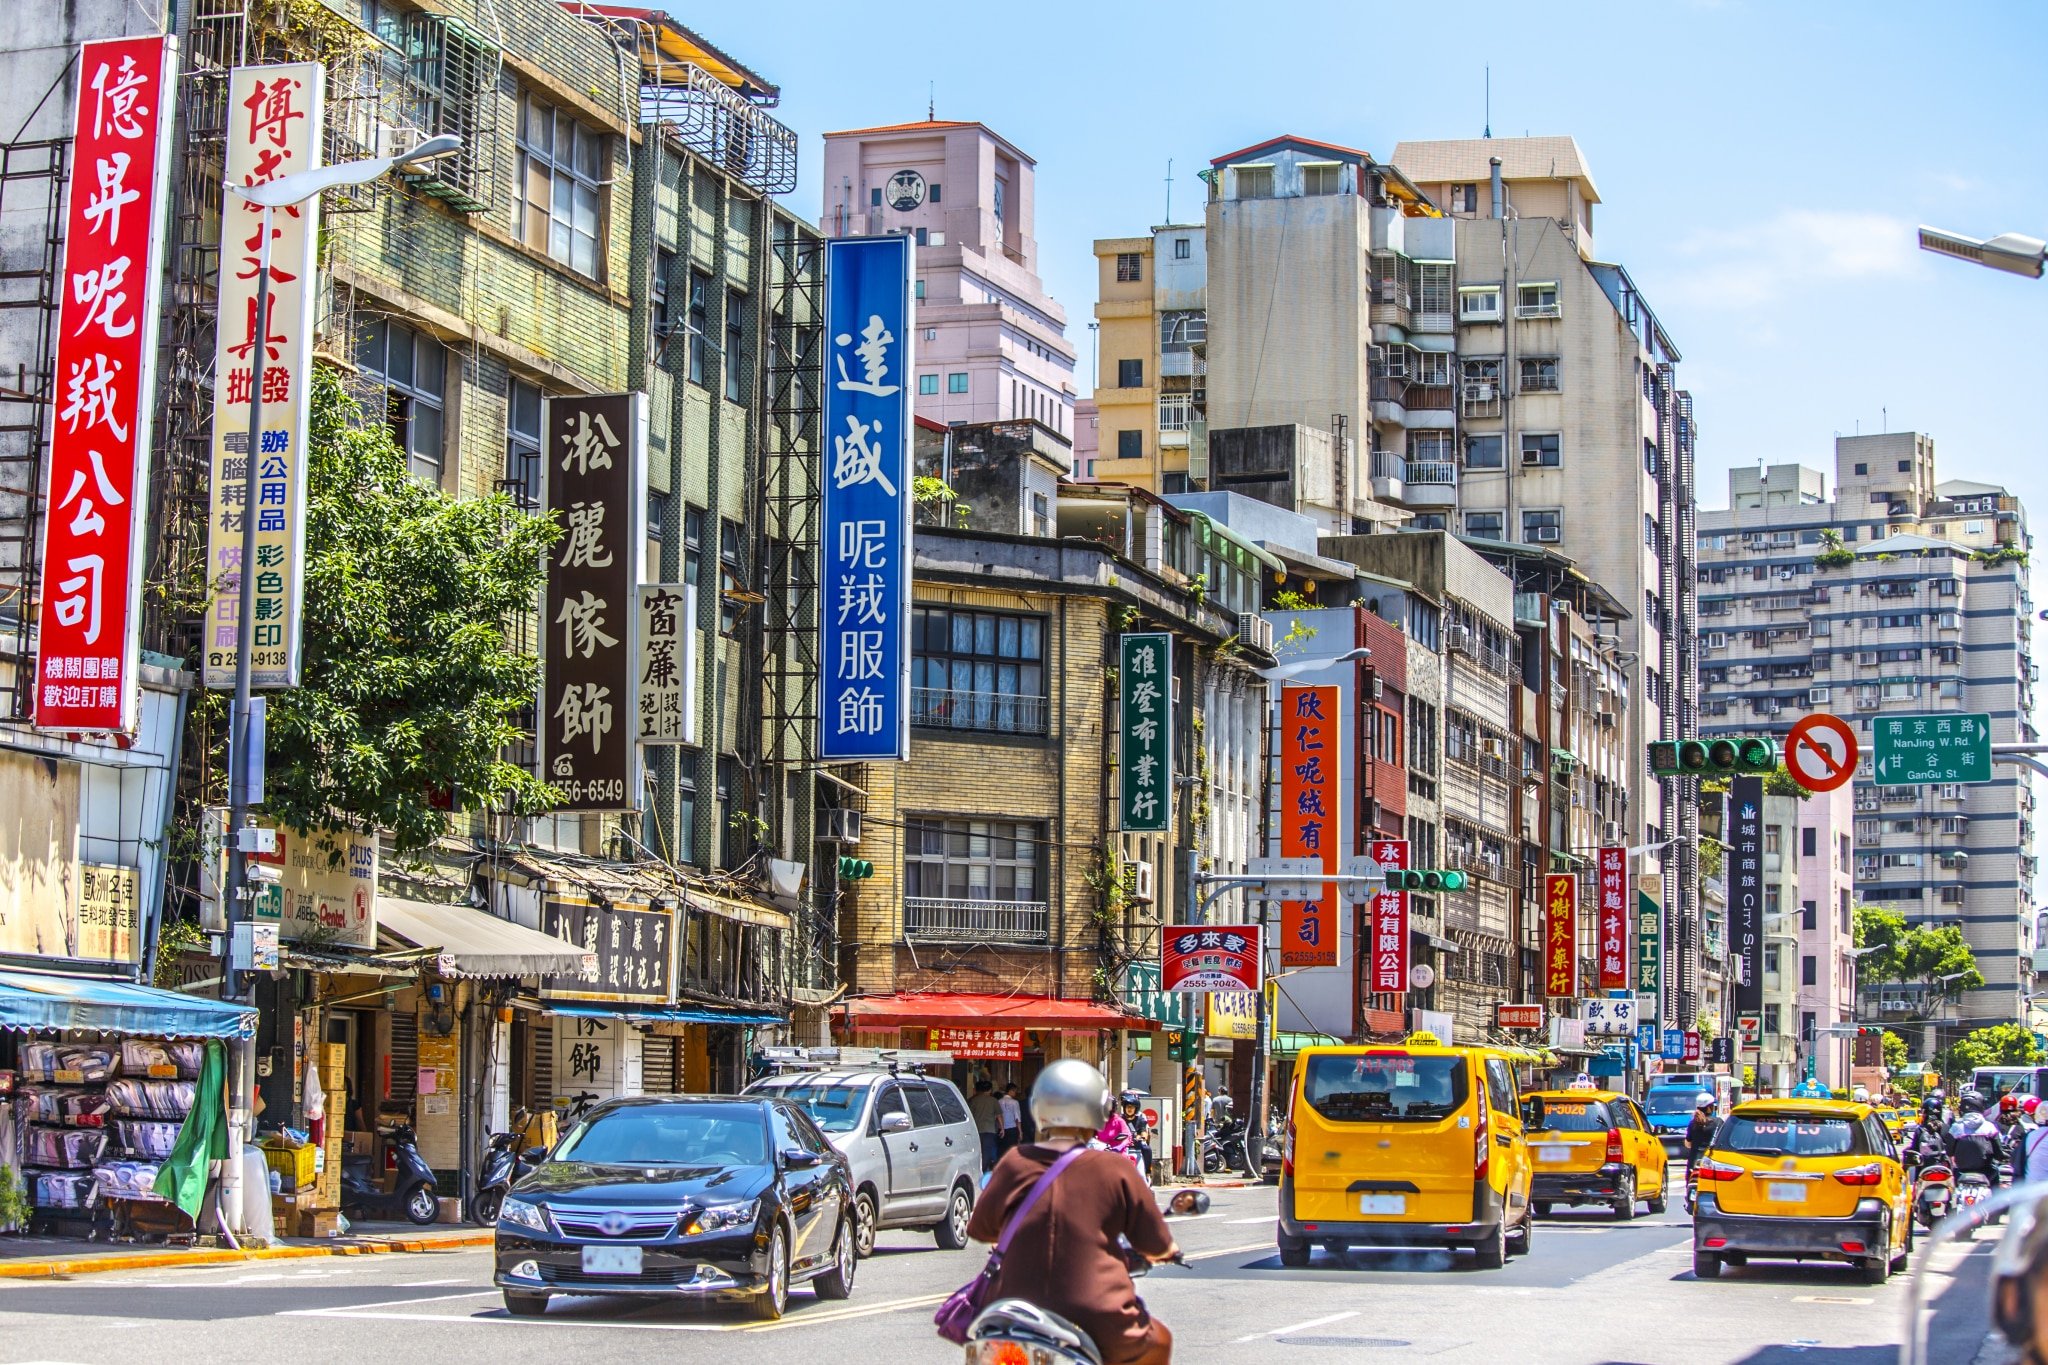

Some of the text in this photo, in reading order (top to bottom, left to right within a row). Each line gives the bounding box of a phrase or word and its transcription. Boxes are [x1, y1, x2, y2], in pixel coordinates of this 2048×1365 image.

[54, 56, 149, 645] 億昇呢羢公司
[226, 366, 291, 404] 批發
[834, 315, 900, 496] 達盛
[219, 431, 250, 533] 電腦耗材
[257, 430, 288, 533] 辦公用品
[254, 543, 285, 648] 彩色影印
[643, 588, 684, 687] 窗簾
[836, 519, 887, 737] 呢羢服飾
[45, 657, 119, 679] 機關團體
[44, 685, 117, 708] 歡迎訂購
[639, 692, 658, 738] 施工
[663, 692, 682, 738] 設計
[1889, 719, 1975, 735] 南京西路
[1890, 752, 1975, 768] 甘谷街
[1894, 737, 1971, 749] NanJing W. Rd.
[1907, 770, 1960, 780] GanGu St.
[1295, 692, 1326, 947] 欣仁呢絨有公司
[349, 845, 372, 866] PLUS
[1741, 824, 1756, 888] 城市商旅
[84, 872, 133, 904] 歐洲名牌
[320, 903, 346, 928] Pentel
[1180, 931, 1246, 954] 多來家
[1294, 951, 1336, 962] 2559-5159
[1183, 980, 1238, 988] 2555-9042
